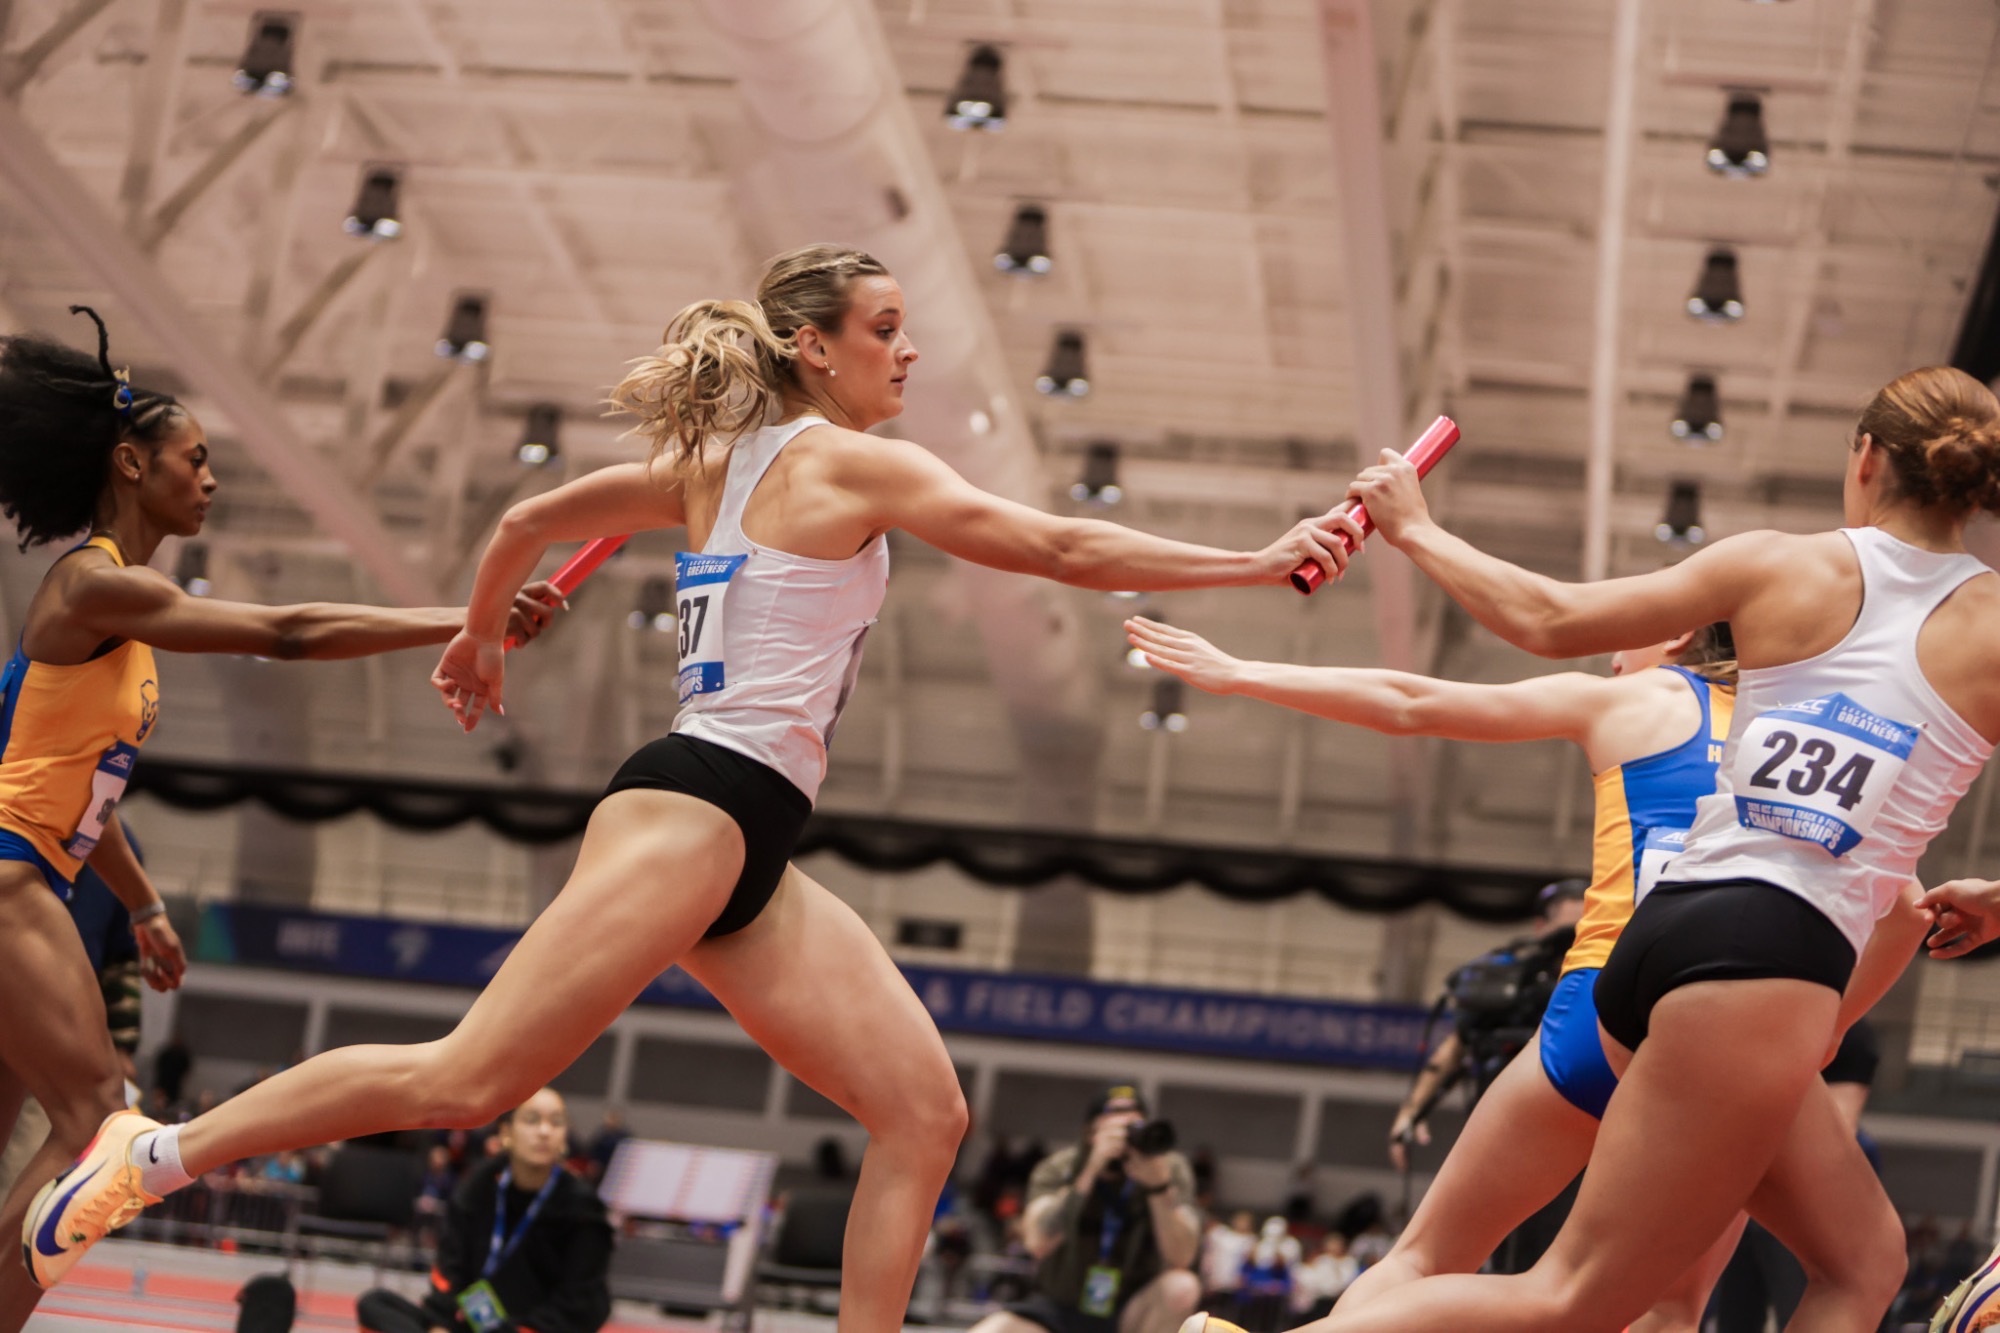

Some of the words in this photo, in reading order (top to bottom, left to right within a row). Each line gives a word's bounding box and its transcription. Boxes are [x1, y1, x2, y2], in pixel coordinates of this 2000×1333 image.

[686, 564, 728, 577] GREATNESS
[678, 595, 709, 662] 37
[1837, 711, 1902, 743] GREATNESS
[1749, 730, 1876, 812] 234
[1748, 811, 1841, 850] CHAMPIONSHIPS
[1795, 809, 1818, 823] TRACK
[1825, 818, 1846, 835] FIELD
[965, 981, 1095, 1031] FIELD
